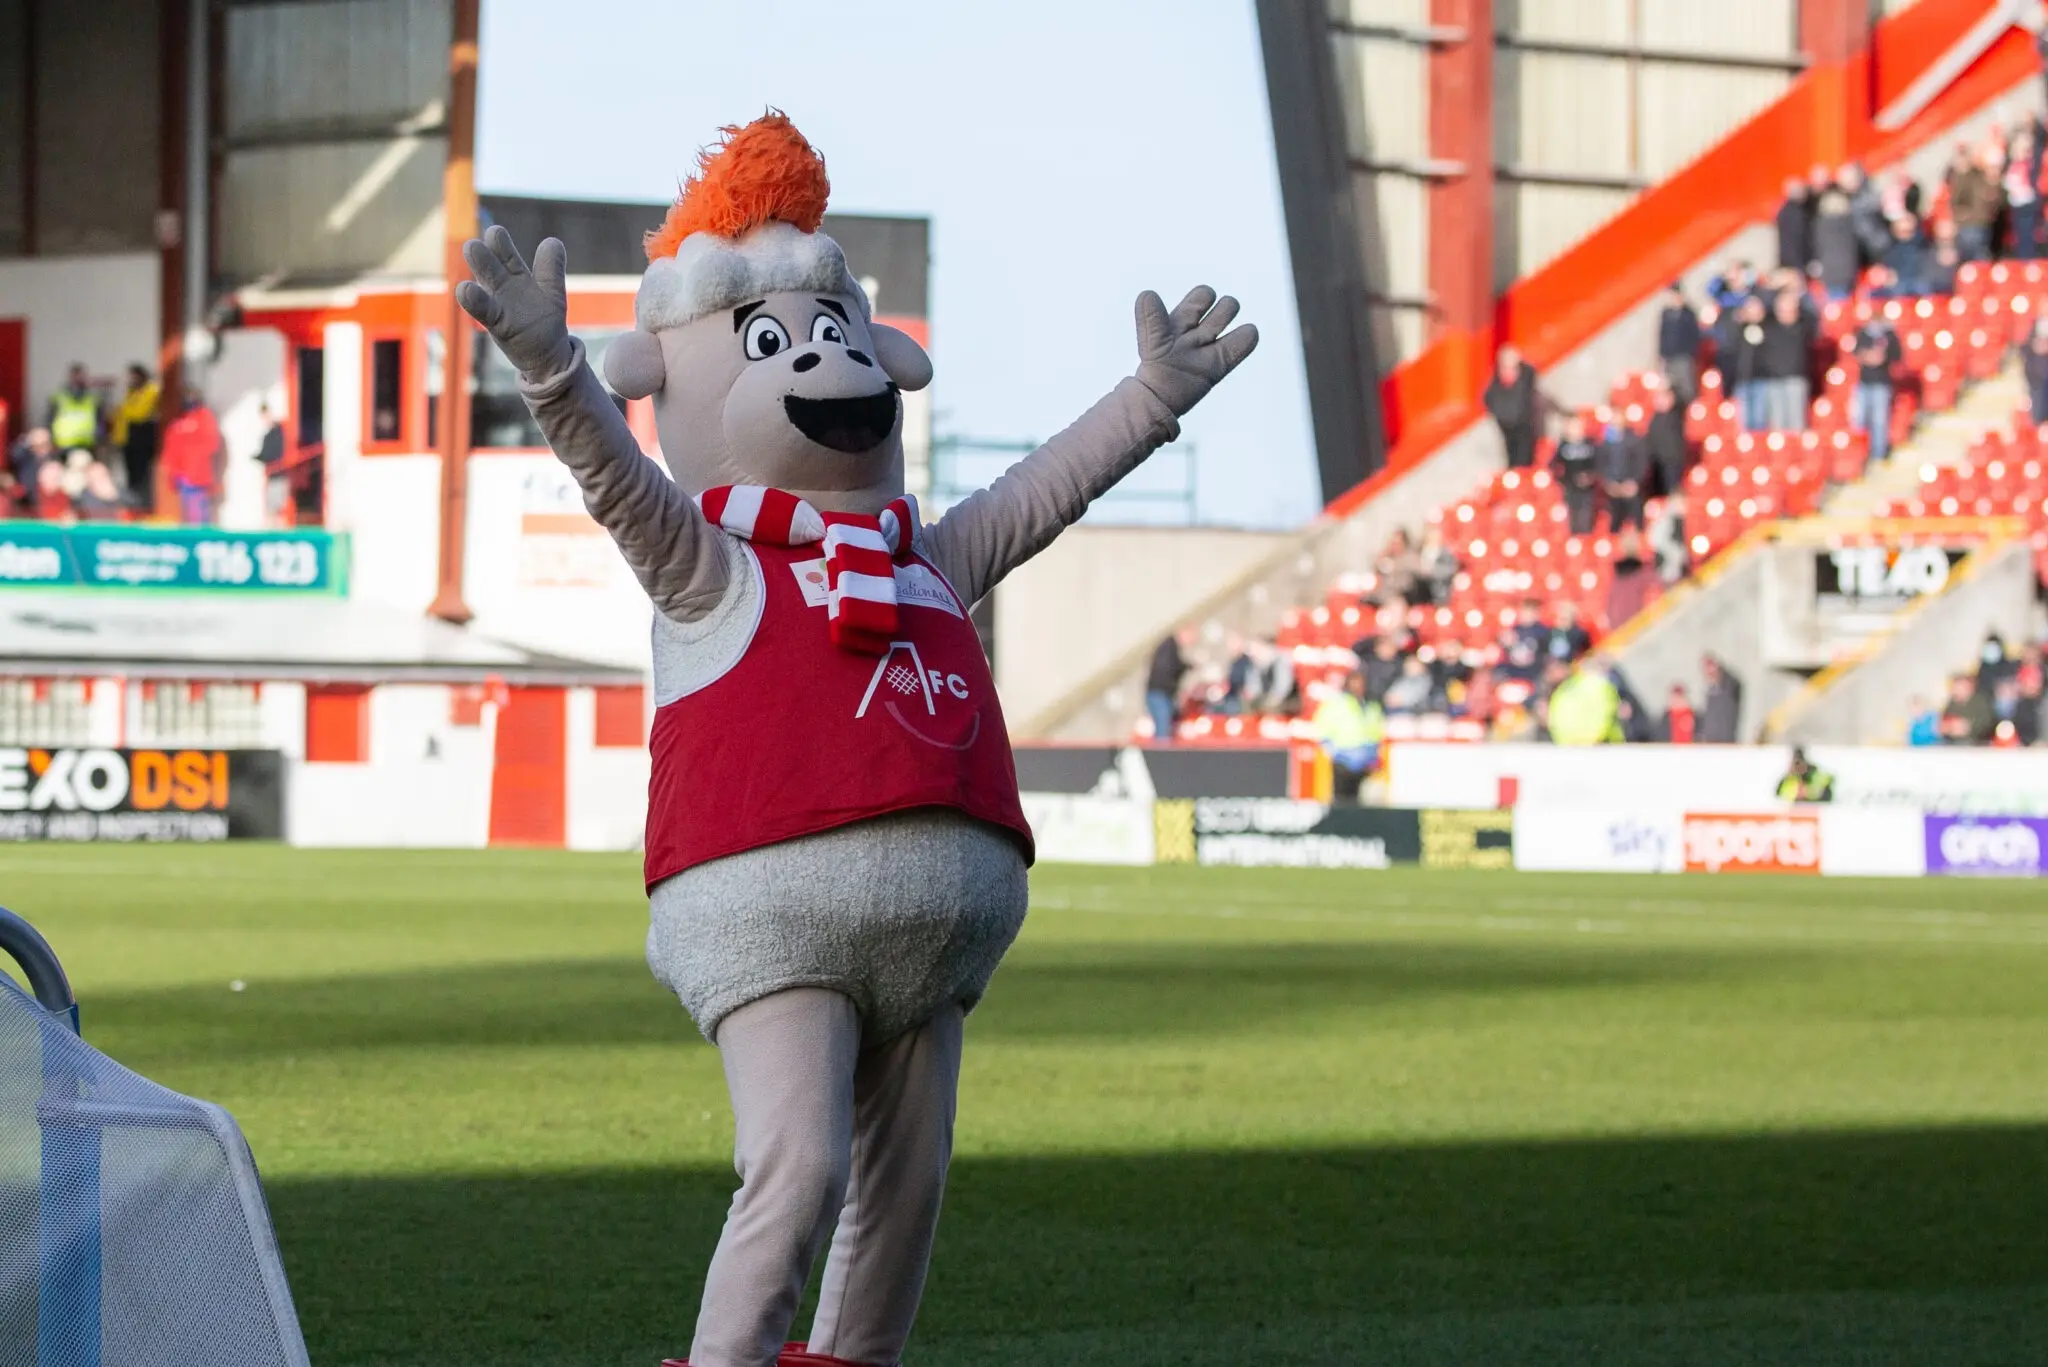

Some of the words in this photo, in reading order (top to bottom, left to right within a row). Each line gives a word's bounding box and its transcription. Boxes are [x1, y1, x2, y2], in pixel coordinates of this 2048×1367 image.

[195, 541, 252, 583] 116
[256, 541, 318, 584] 123
[1829, 547, 1950, 596] TEXO
[131, 750, 229, 811] DSI
[98, 812, 229, 841] INSPECTION
[1685, 820, 1818, 873] sports
[1198, 834, 1390, 869] INTERNATIONAL
